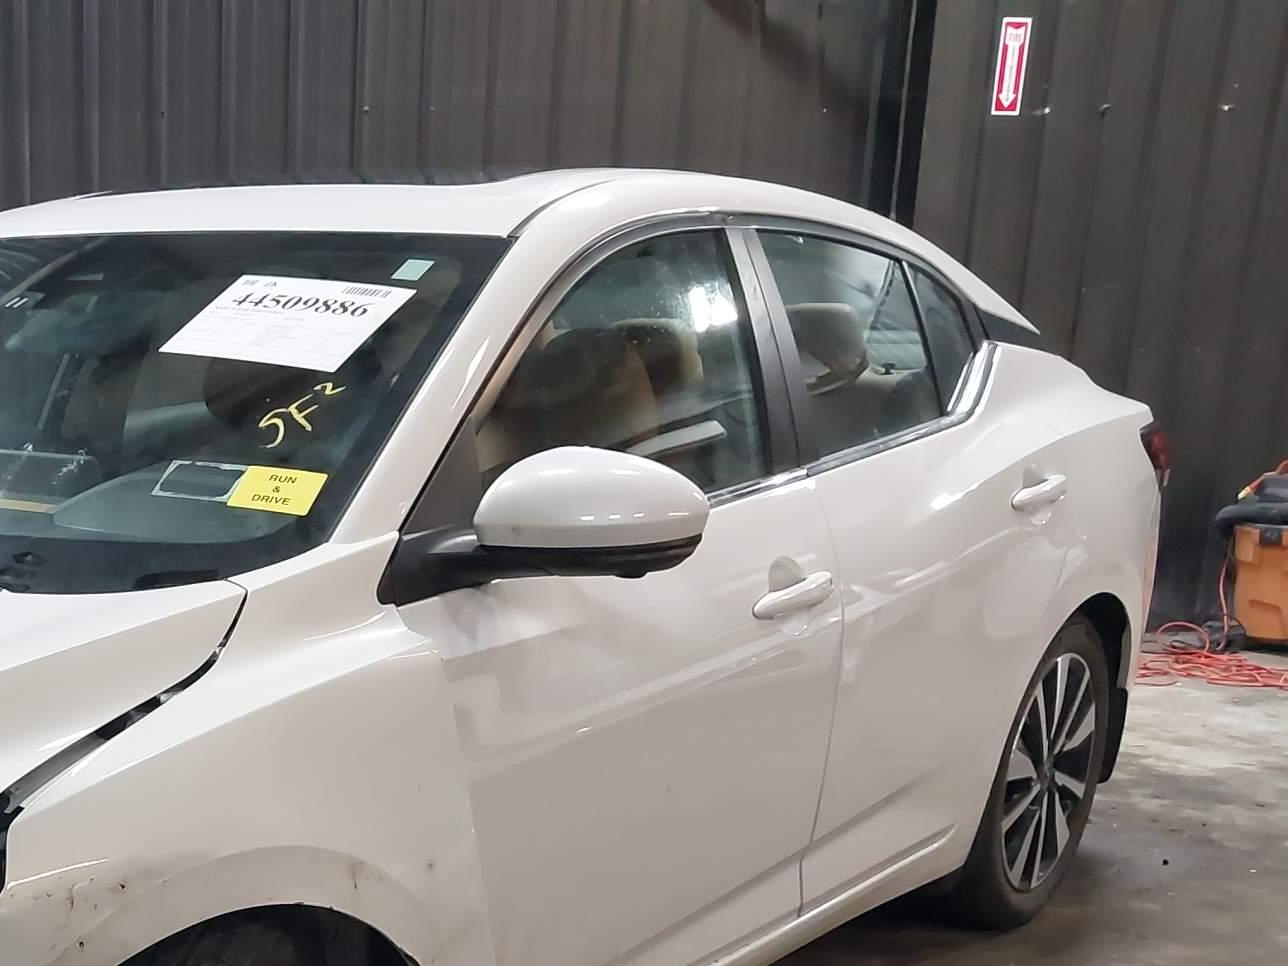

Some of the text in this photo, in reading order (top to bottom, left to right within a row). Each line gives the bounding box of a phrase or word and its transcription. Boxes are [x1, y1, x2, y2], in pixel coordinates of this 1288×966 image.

[232, 292, 374, 318] 44509886
[269, 474, 297, 484] RUN
[251, 494, 292, 506] DRIVE
